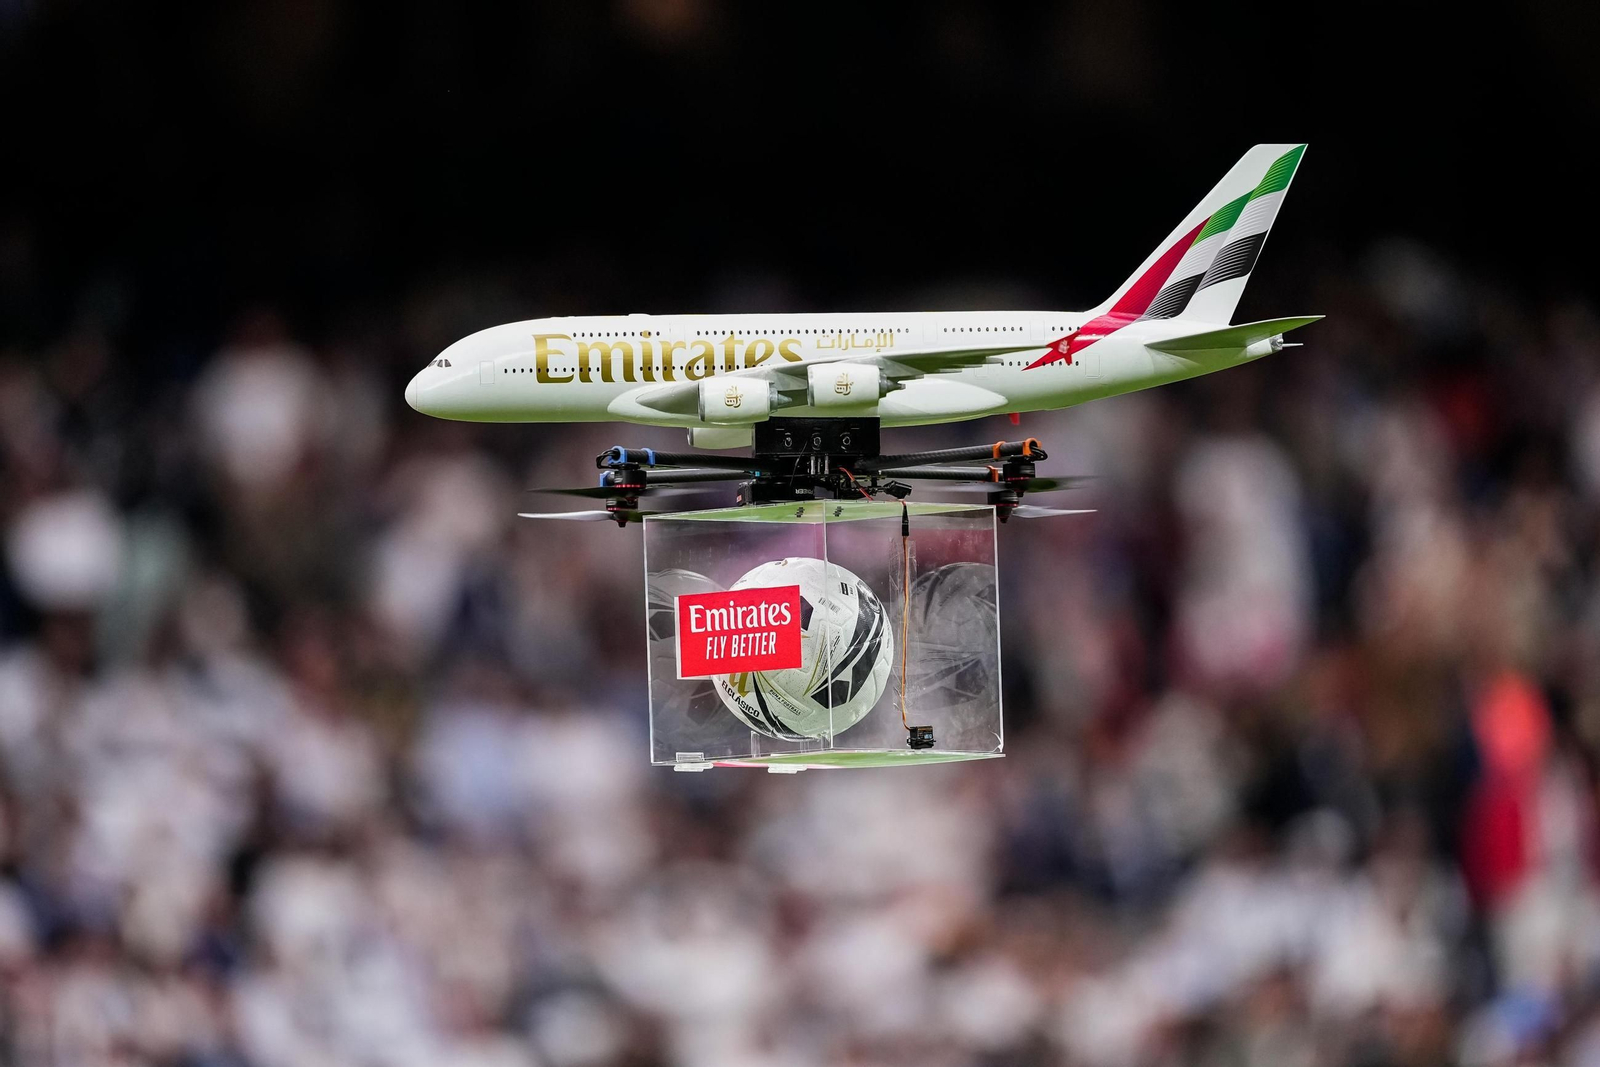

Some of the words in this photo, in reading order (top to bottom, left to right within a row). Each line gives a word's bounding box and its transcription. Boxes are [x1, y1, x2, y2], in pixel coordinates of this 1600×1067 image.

[532, 330, 804, 383] Emirates
[689, 600, 792, 634] Emirates
[706, 635, 727, 660] FLY
[731, 631, 777, 658] BETTER
